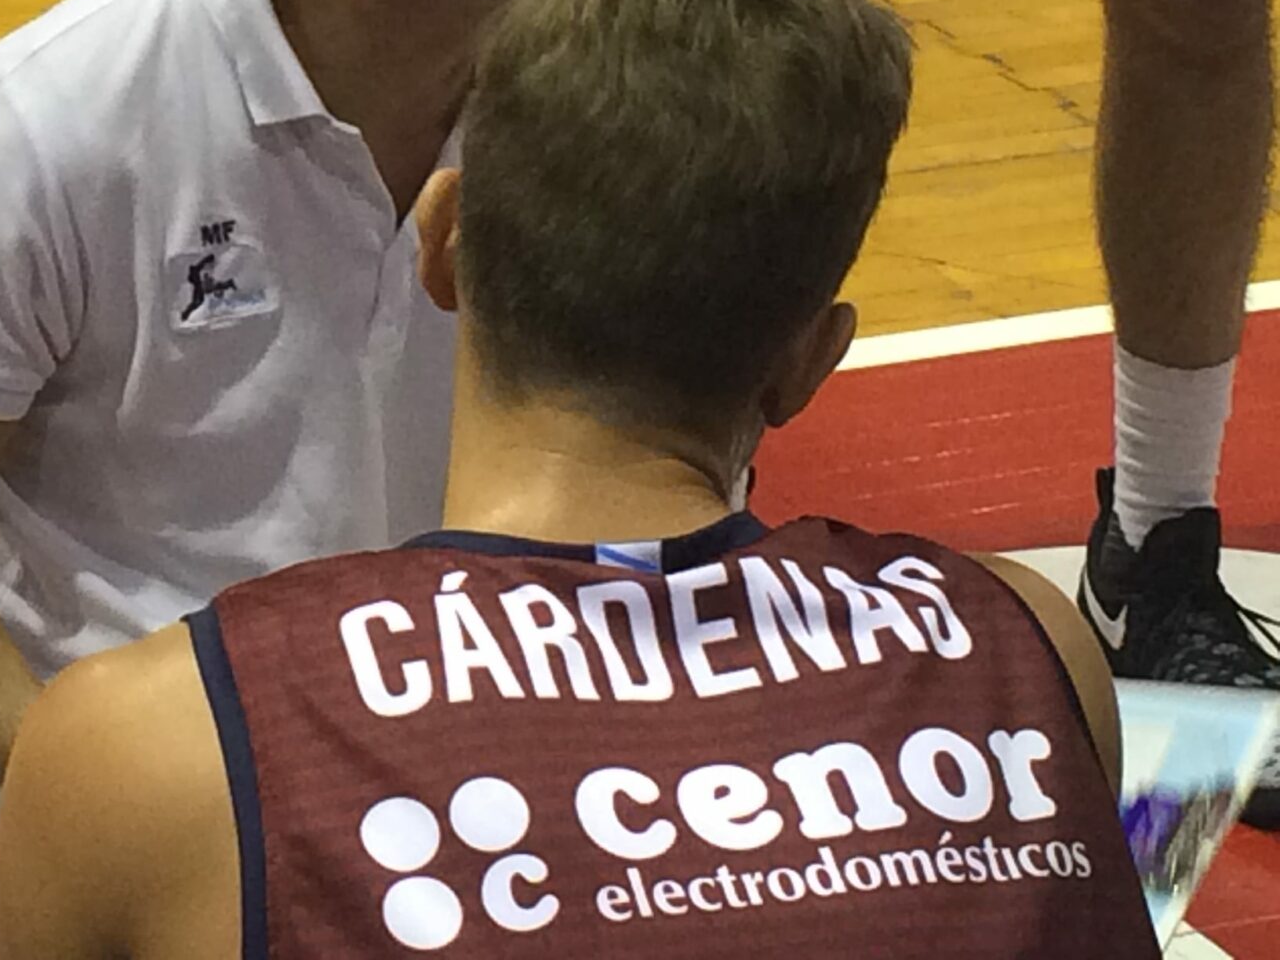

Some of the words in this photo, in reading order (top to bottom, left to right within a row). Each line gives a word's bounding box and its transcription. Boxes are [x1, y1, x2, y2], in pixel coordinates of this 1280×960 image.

[200, 219, 236, 247] MF
[339, 555, 973, 717] CÁRDENAS
[575, 727, 1057, 860] cenor
[596, 830, 1091, 923] electrodomésticos
